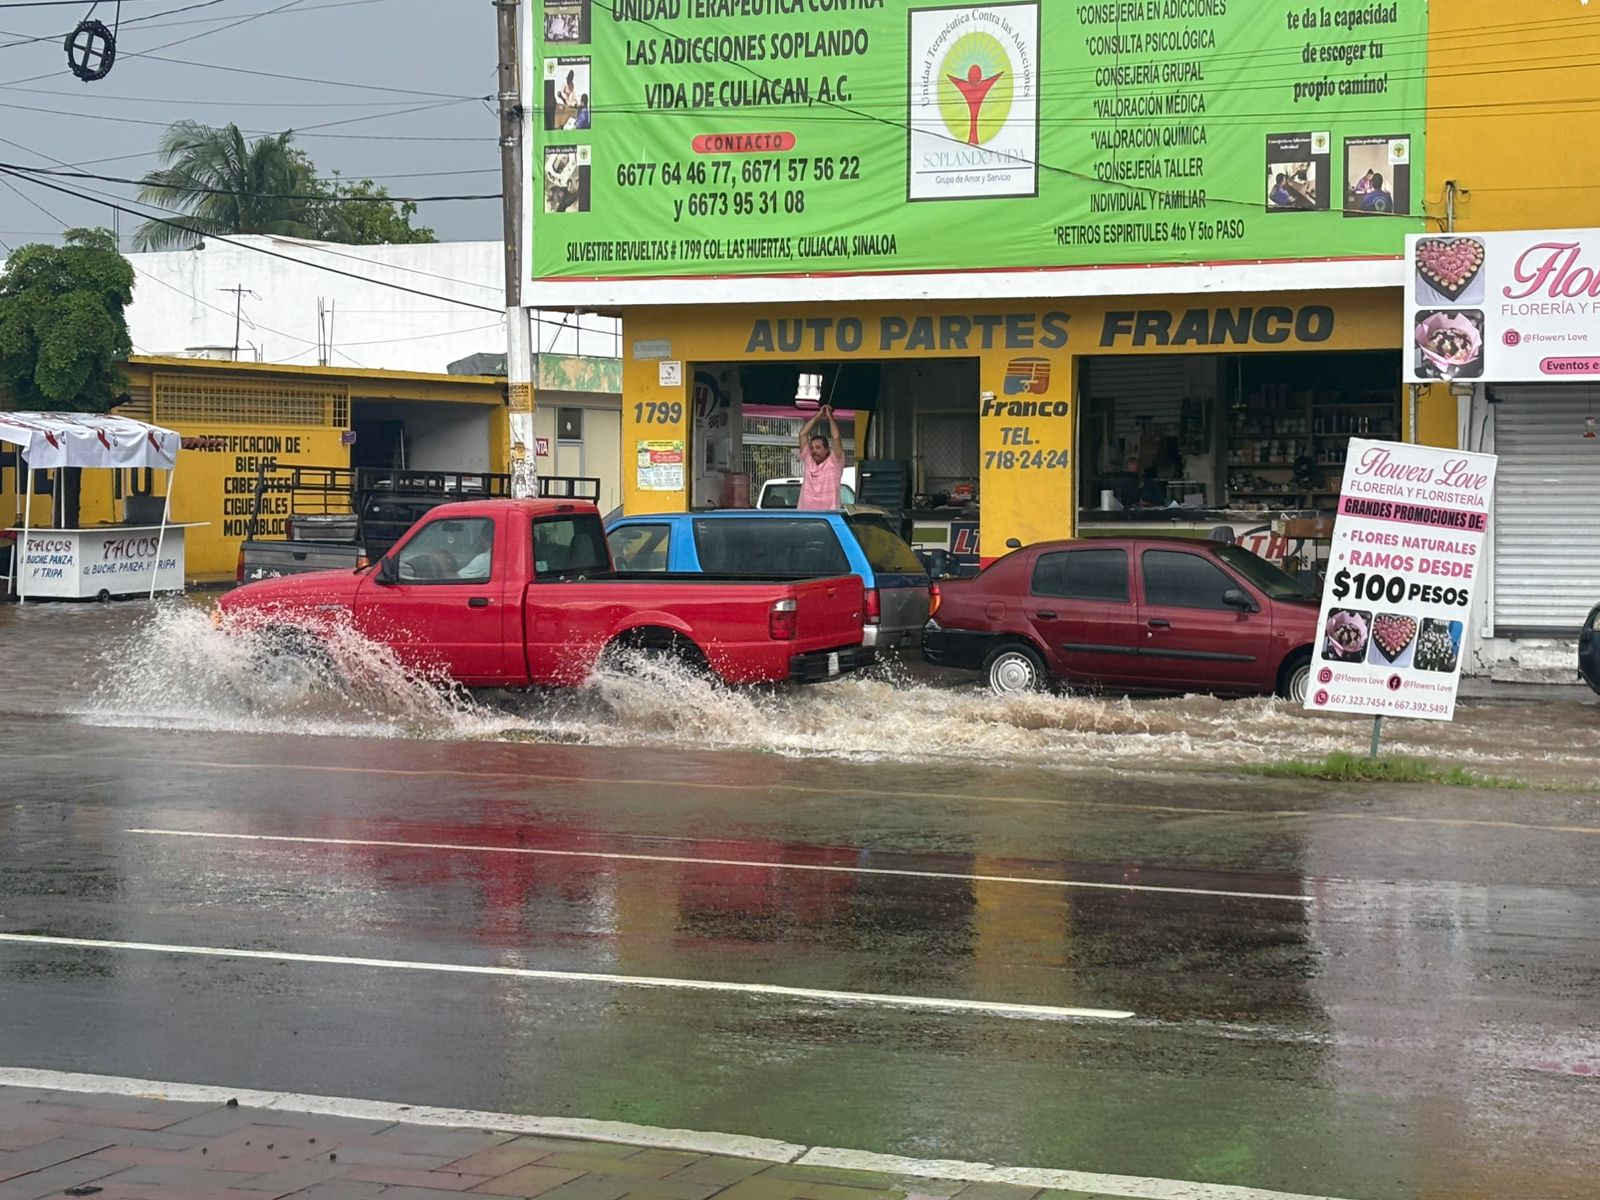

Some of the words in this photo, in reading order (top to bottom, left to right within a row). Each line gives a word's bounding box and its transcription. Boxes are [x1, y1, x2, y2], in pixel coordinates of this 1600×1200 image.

[612, 0, 679, 22] UNIDAD
[1147, 2, 1160, 21] EN
[1163, 0, 1226, 19] ADICCIONES
[1287, 11, 1300, 30] te
[1302, 8, 1317, 29] da
[1320, 6, 1331, 28] la
[1334, 2, 1397, 30] capacidad
[626, 39, 657, 66] LAS
[660, 34, 766, 65] ADICCIONES
[770, 28, 869, 60] SOPLANDO
[1145, 25, 1215, 52] PSICOLÓGICA
[921, 60, 932, 107] Unidad
[927, 14, 970, 58] Terapéutica
[971, 9, 1000, 25] Contra
[1001, 17, 1013, 35] las
[1011, 31, 1032, 98] Adicciones
[1302, 42, 1317, 63] de
[1320, 44, 1366, 66] escoger
[1369, 40, 1383, 59] tu
[1096, 60, 1160, 87] CONSEJERÍA
[1162, 61, 1204, 82] GRUPAL
[645, 83, 688, 110] VIDA
[693, 81, 715, 109] DE
[719, 77, 813, 107] CULIACAN,
[817, 75, 852, 102] A.C.
[1293, 75, 1336, 103] propio
[1338, 72, 1388, 95] camino!
[1166, 90, 1205, 115] MÉDICA
[704, 135, 783, 151] CONTACTO
[1163, 122, 1207, 147] QUÍMICA
[922, 150, 993, 168] SOPLANDO
[1164, 157, 1204, 178] TALLER
[617, 162, 656, 187] 6677
[661, 161, 682, 186] 64
[686, 161, 706, 185] 46
[711, 160, 736, 188] 77,
[741, 158, 781, 184] 6671
[787, 158, 807, 182] 57
[813, 156, 834, 181] 56
[839, 155, 860, 180] 22
[935, 175, 955, 185] Grupo
[955, 174, 964, 183] de
[964, 173, 982, 183] Amor
[981, 175, 986, 184] y
[987, 173, 1012, 183] Servicio
[673, 198, 683, 222] y
[688, 191, 728, 217] 6673
[734, 191, 753, 215] 95
[759, 190, 777, 214] 31
[784, 190, 805, 214] 08
[1090, 192, 1147, 213] INDIVIDUAL
[1149, 191, 1157, 210] Y
[1158, 189, 1207, 210] FAMILIAR
[1104, 222, 1168, 243] ESPIRITULES
[1171, 222, 1187, 241] 4to
[1189, 221, 1196, 240] Y
[1198, 221, 1213, 240] 5to
[1216, 219, 1245, 239] PASO
[566, 241, 613, 262] SILVESTRE
[615, 240, 669, 262] REVUELTAS
[670, 240, 677, 260] #
[679, 239, 701, 260] 1799
[703, 238, 725, 260] COL.
[727, 238, 745, 259] LAS
[746, 237, 793, 261] HUERTAS,
[798, 235, 850, 259] CULIACAN,
[852, 234, 897, 256] SINALOA
[1501, 301, 1575, 316] FLORERÍA
[1577, 302, 1589, 314] Y
[744, 317, 871, 353] AUTO
[879, 311, 1072, 351] PARTES
[1098, 305, 1335, 347] FRANCO
[1523, 334, 1565, 343] @Flowers
[1567, 333, 1588, 341] Love
[1547, 361, 1589, 371] Eventos
[634, 401, 683, 424] 1799
[981, 395, 1069, 417] Franco
[286, 437, 300, 453] DE
[1000, 427, 1041, 446] TEL.
[235, 456, 277, 473] BIELAS
[1354, 447, 1434, 483] Flowers
[1435, 459, 1488, 490] Love
[1350, 480, 1404, 497] FLORERÍA
[1406, 487, 1414, 498] Y
[1416, 488, 1485, 507] FLORISTERÍA
[224, 498, 288, 515] CIGUEALES
[1344, 498, 1392, 519] GRANDES
[1393, 504, 1467, 528] PROMOCIONES
[1467, 514, 1484, 530] DE:
[27, 539, 72, 552] TACOS
[103, 537, 160, 560] TACOS
[1350, 529, 1399, 546] FLORES
[1402, 536, 1477, 556] NATURALES
[32, 567, 39, 577] Y
[41, 568, 63, 578] TRIPA
[1349, 550, 1414, 572] RAMOS
[1418, 558, 1474, 579] DESDE
[1332, 567, 1405, 604] $100
[1408, 583, 1469, 607] PESOS
[1334, 673, 1368, 684] @Flowers
[1369, 676, 1385, 686] Love
[1403, 680, 1436, 691] @Flowers
[1437, 684, 1453, 693] Love
